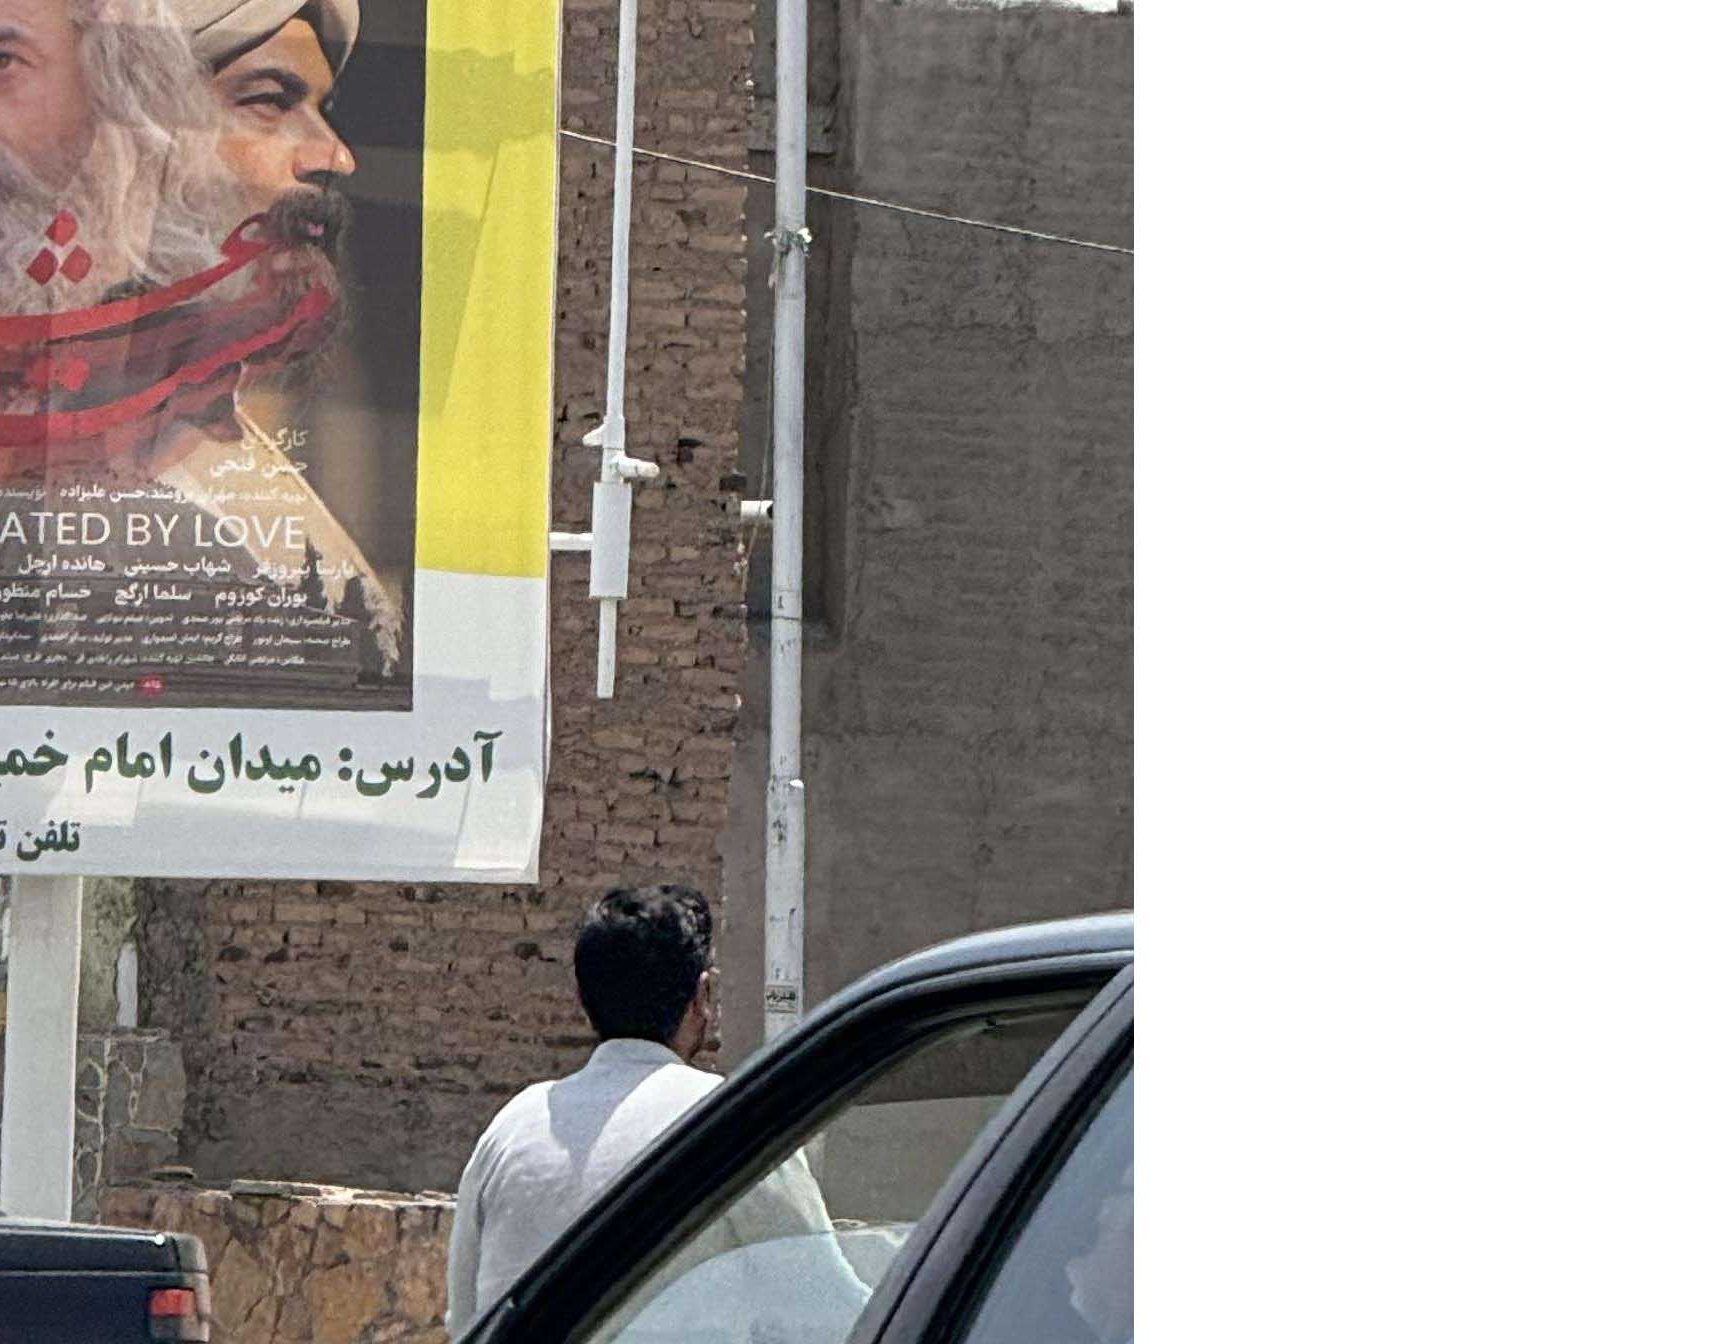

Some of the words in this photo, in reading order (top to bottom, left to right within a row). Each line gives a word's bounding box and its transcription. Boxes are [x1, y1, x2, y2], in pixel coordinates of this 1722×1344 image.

[126, 512, 179, 547] BY
[194, 514, 306, 550] LOVE
[123, 559, 179, 578] حسینی
[182, 557, 231, 577] شهاب
[45, 582, 93, 605] حسام
[152, 584, 192, 603] سلما
[84, 732, 173, 791] امام
[187, 735, 323, 794] میدان
[338, 727, 504, 801] آدرس:
[15, 819, 82, 859] تلفن
